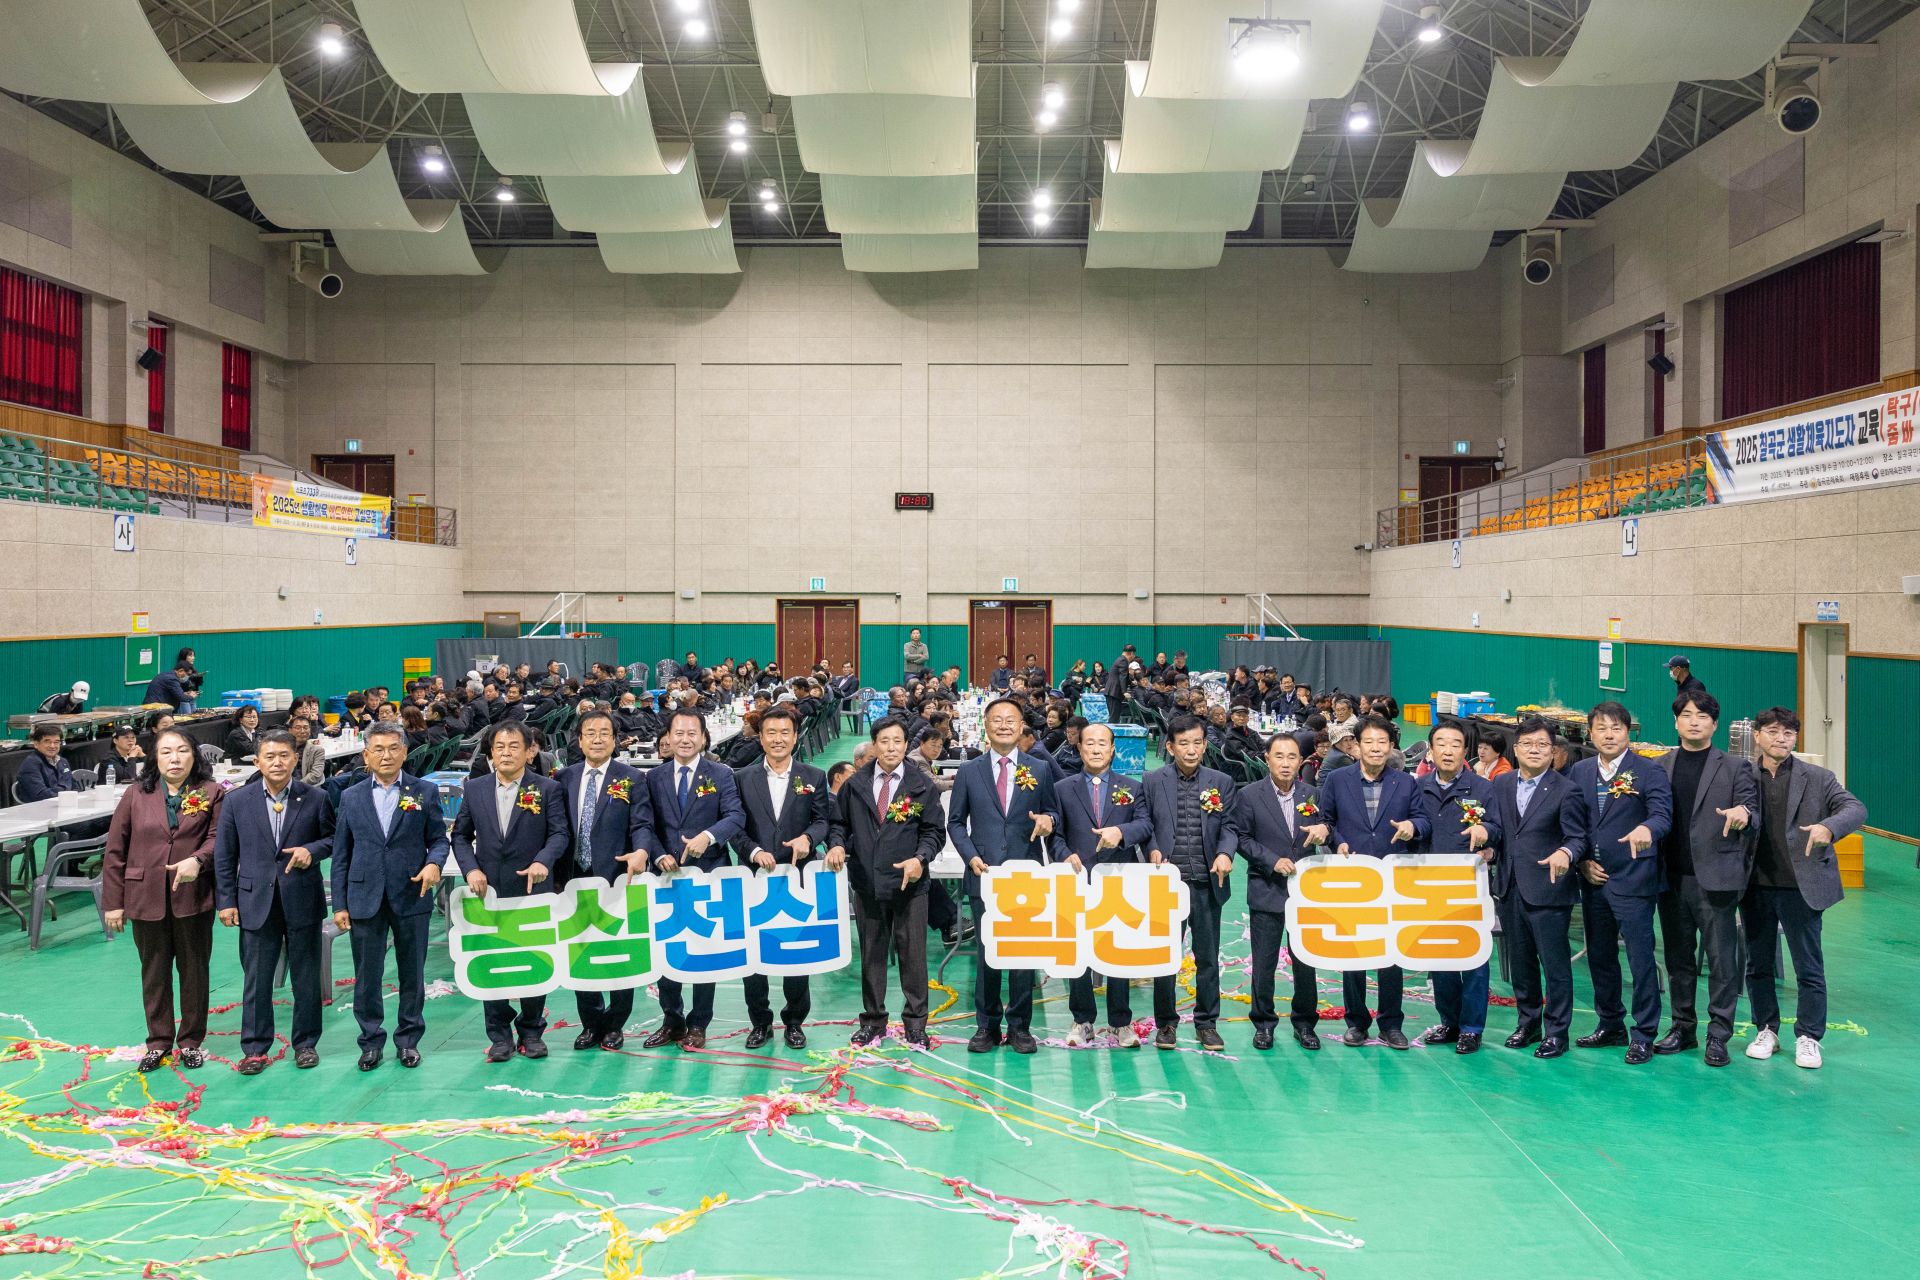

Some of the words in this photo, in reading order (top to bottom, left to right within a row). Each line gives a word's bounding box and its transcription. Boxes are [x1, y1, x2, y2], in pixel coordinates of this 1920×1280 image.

[1736, 434, 1758, 465] 2025
[1759, 429, 1785, 462] 칠곡군
[1787, 414, 1856, 457] 생활체육지도자
[272, 495, 300, 515] 2025년
[118, 522, 132, 546] 사
[1625, 526, 1636, 550] 나
[461, 872, 840, 988] 농심천심
[992, 872, 1178, 966] 확산
[1297, 866, 1483, 959] 운동
